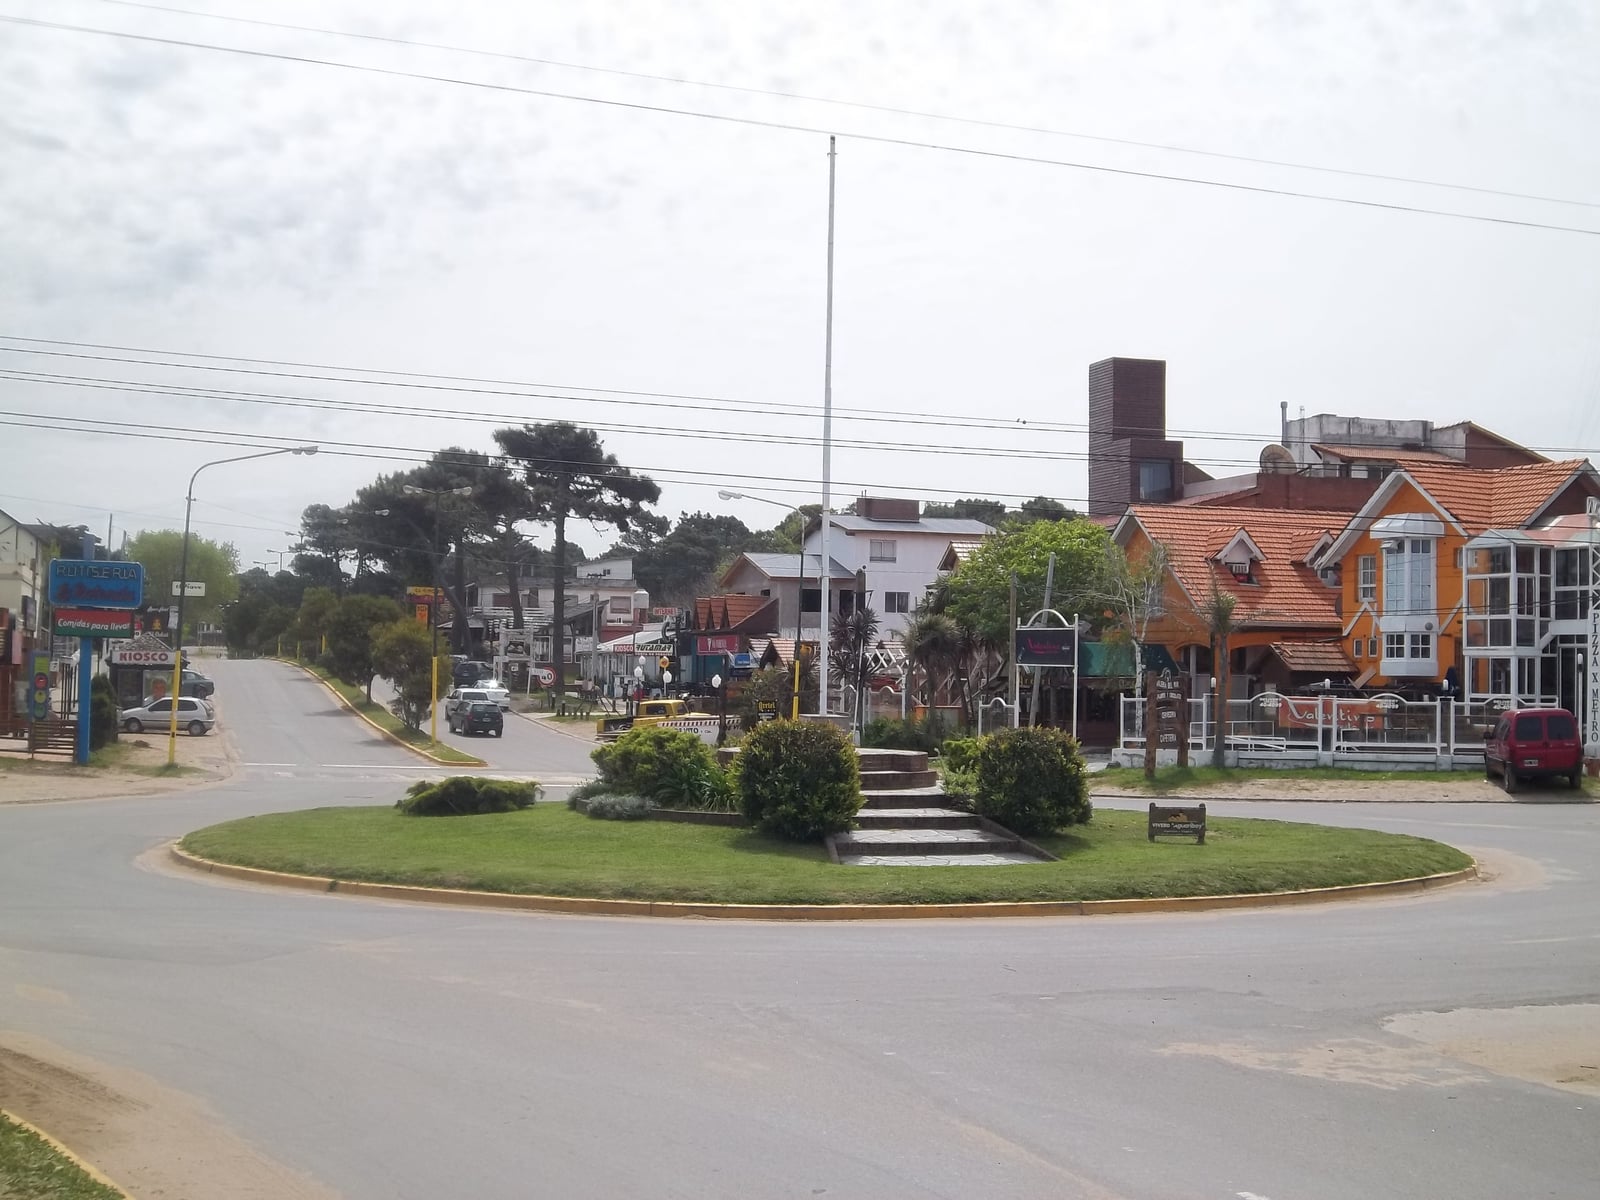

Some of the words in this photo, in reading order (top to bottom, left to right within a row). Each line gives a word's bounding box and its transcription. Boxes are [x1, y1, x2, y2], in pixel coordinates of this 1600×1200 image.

[58, 618, 90, 629] Comidas
[90, 623, 109, 631] para
[110, 622, 131, 632] llevar
[1591, 612, 1600, 667] PIZZA
[118, 652, 169, 662] KIOSCO
[1591, 672, 1600, 683] X
[1591, 687, 1600, 743] METRO
